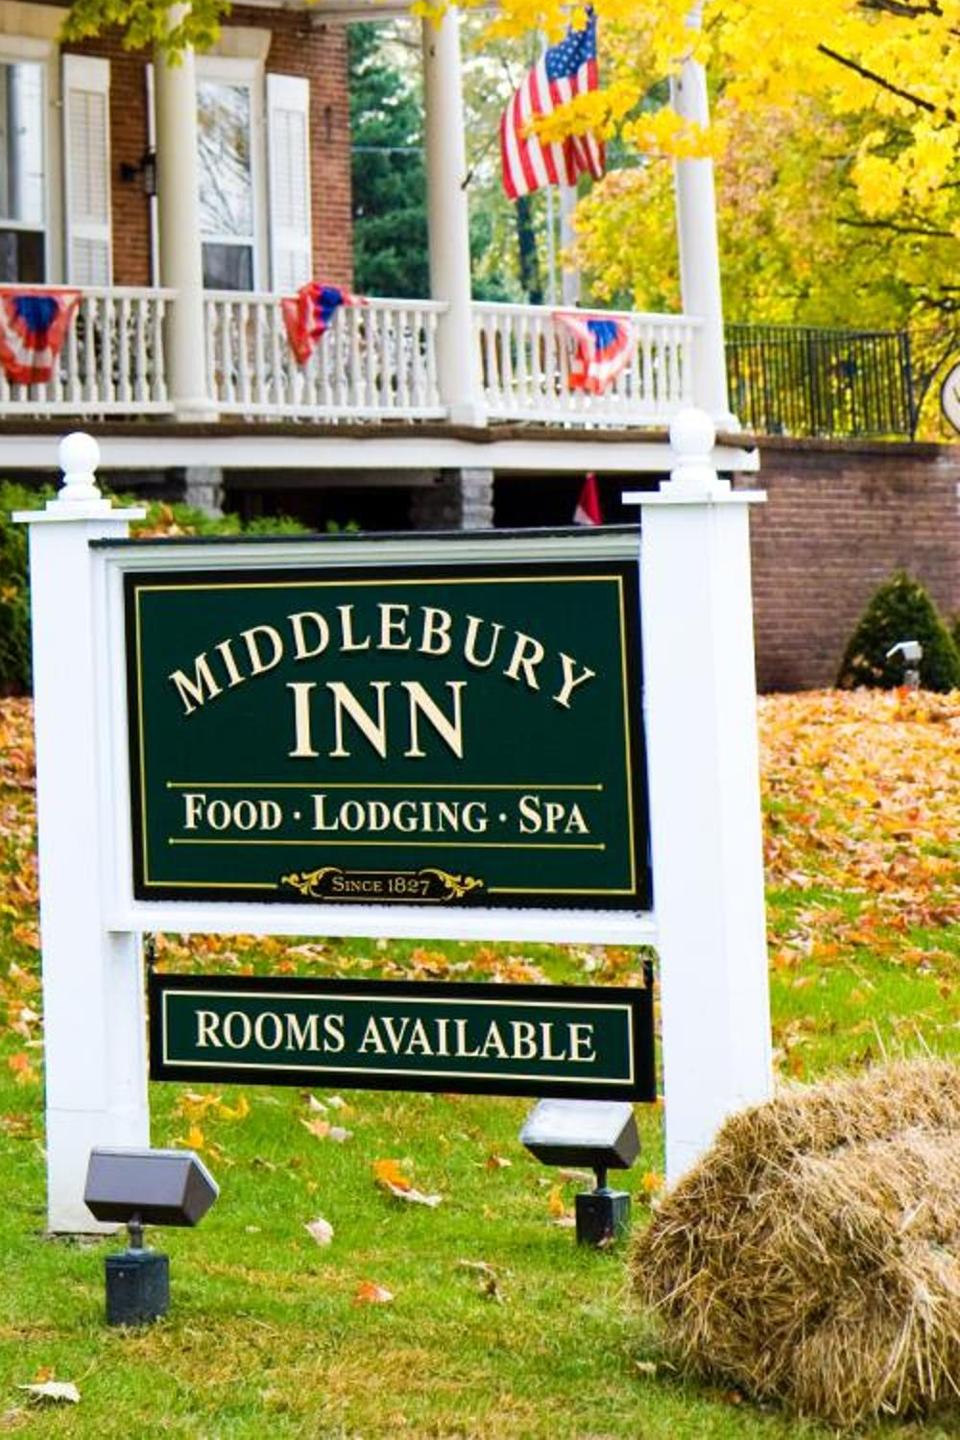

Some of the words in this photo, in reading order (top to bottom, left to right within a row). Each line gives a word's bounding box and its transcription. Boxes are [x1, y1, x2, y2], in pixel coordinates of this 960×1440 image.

[167, 602, 596, 715] MIDDLEBURY
[286, 680, 467, 759] INN
[182, 794, 282, 831] FOOD
[311, 794, 488, 834] LODGING
[518, 795, 590, 835] SPA
[387, 877, 430, 896] 1827
[194, 1009, 345, 1052] ROOMS
[357, 1015, 597, 1062] AVAILABLE
